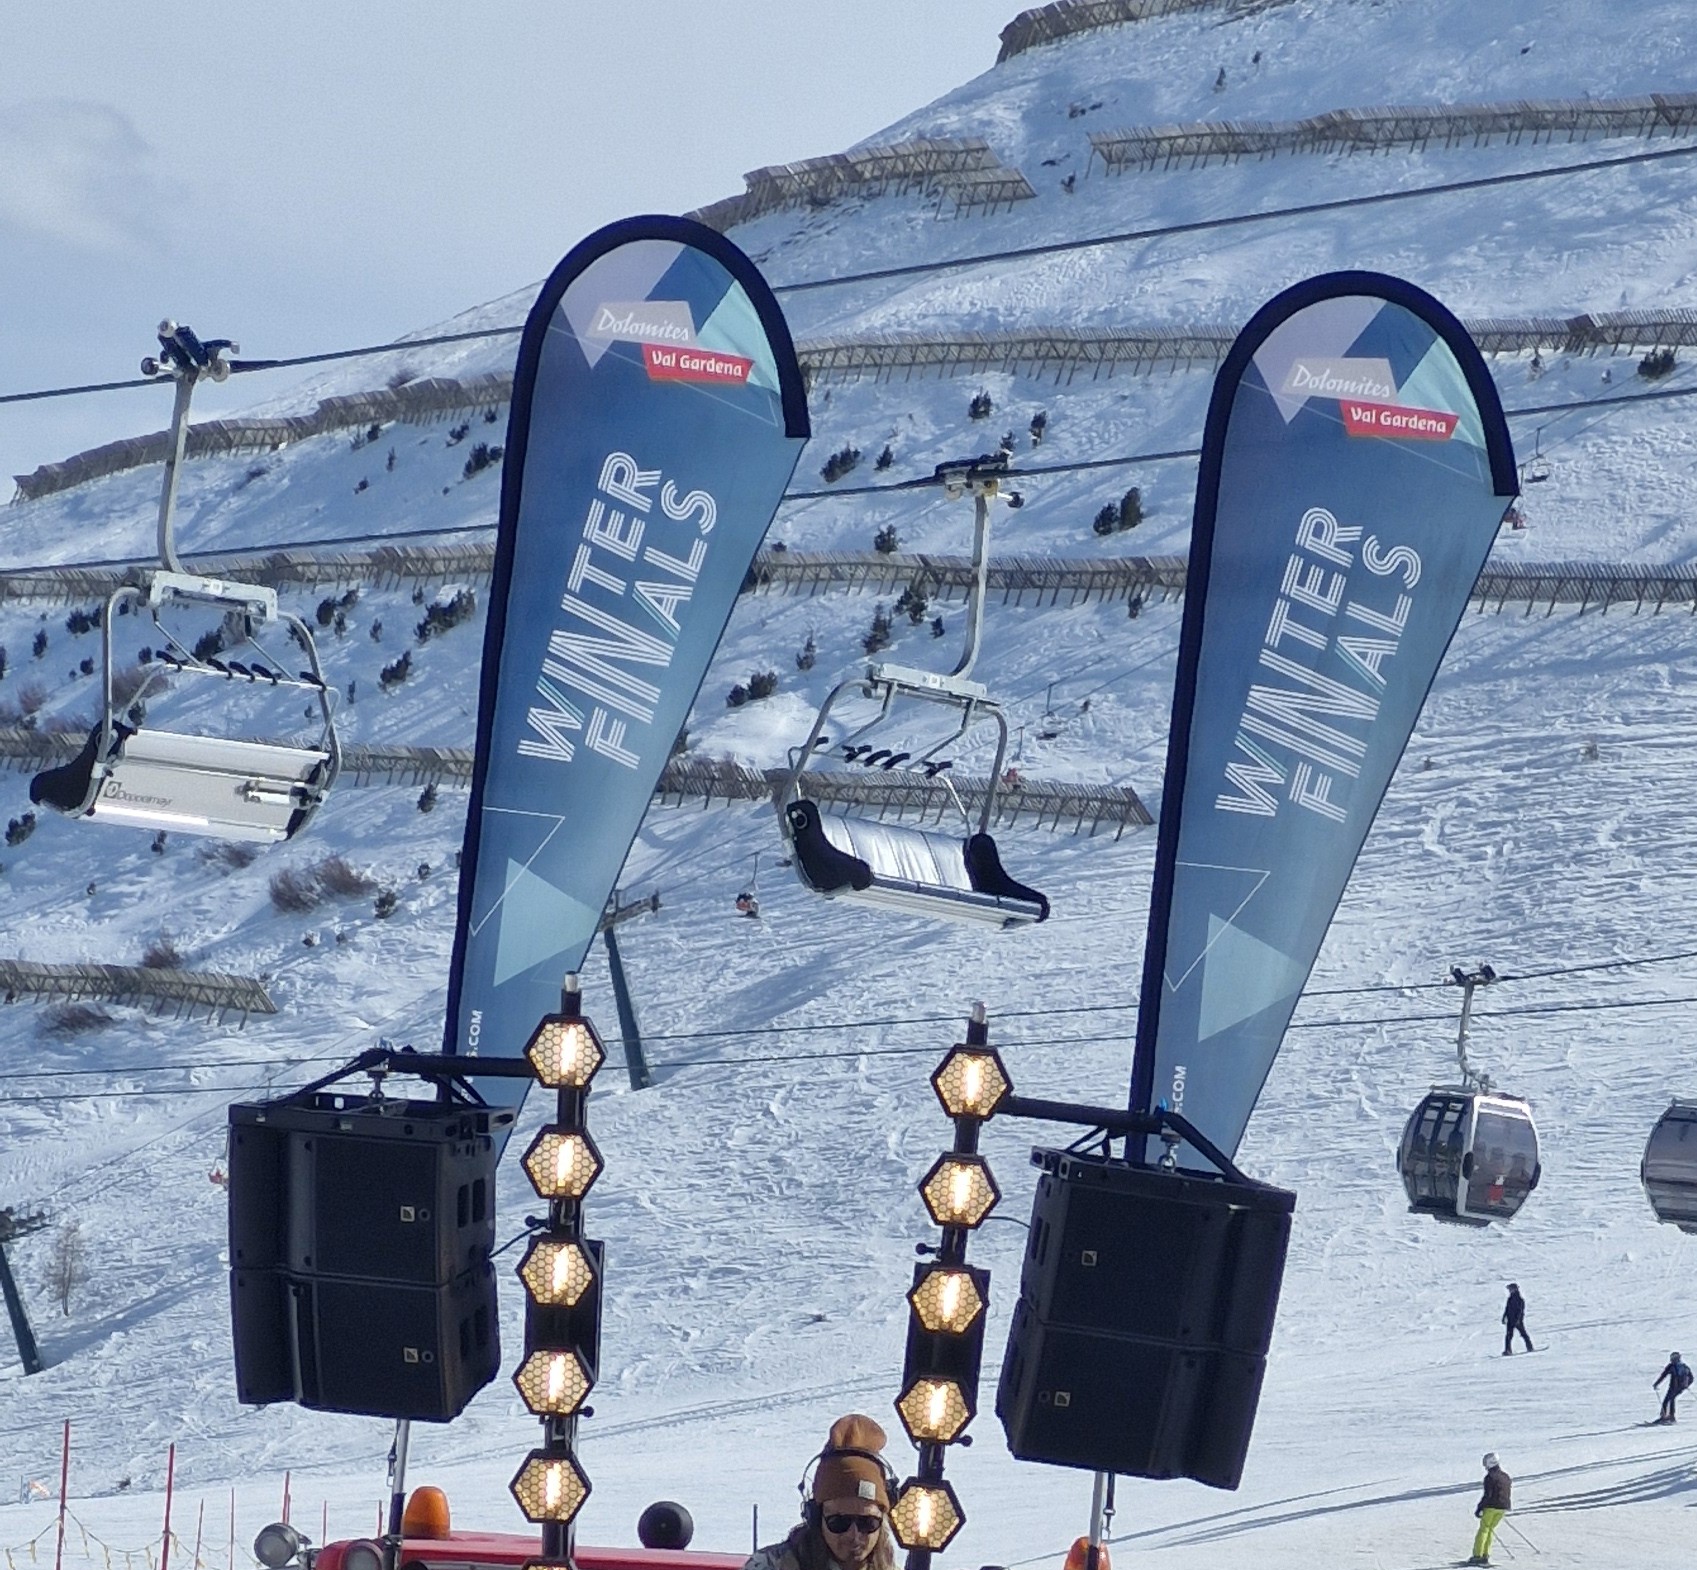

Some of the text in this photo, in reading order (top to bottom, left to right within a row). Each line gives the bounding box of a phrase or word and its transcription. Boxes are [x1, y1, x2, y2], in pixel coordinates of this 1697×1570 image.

[597, 308, 689, 341] Dolomites
[651, 350, 743, 378] Val Gardena
[1292, 364, 1391, 398] Dolomites
[1350, 406, 1447, 434] Val Gardena
[517, 451, 674, 762] WINTER
[541, 479, 717, 770] FINALS
[1214, 507, 1380, 818] WINTER
[1239, 534, 1422, 824] FINALS
